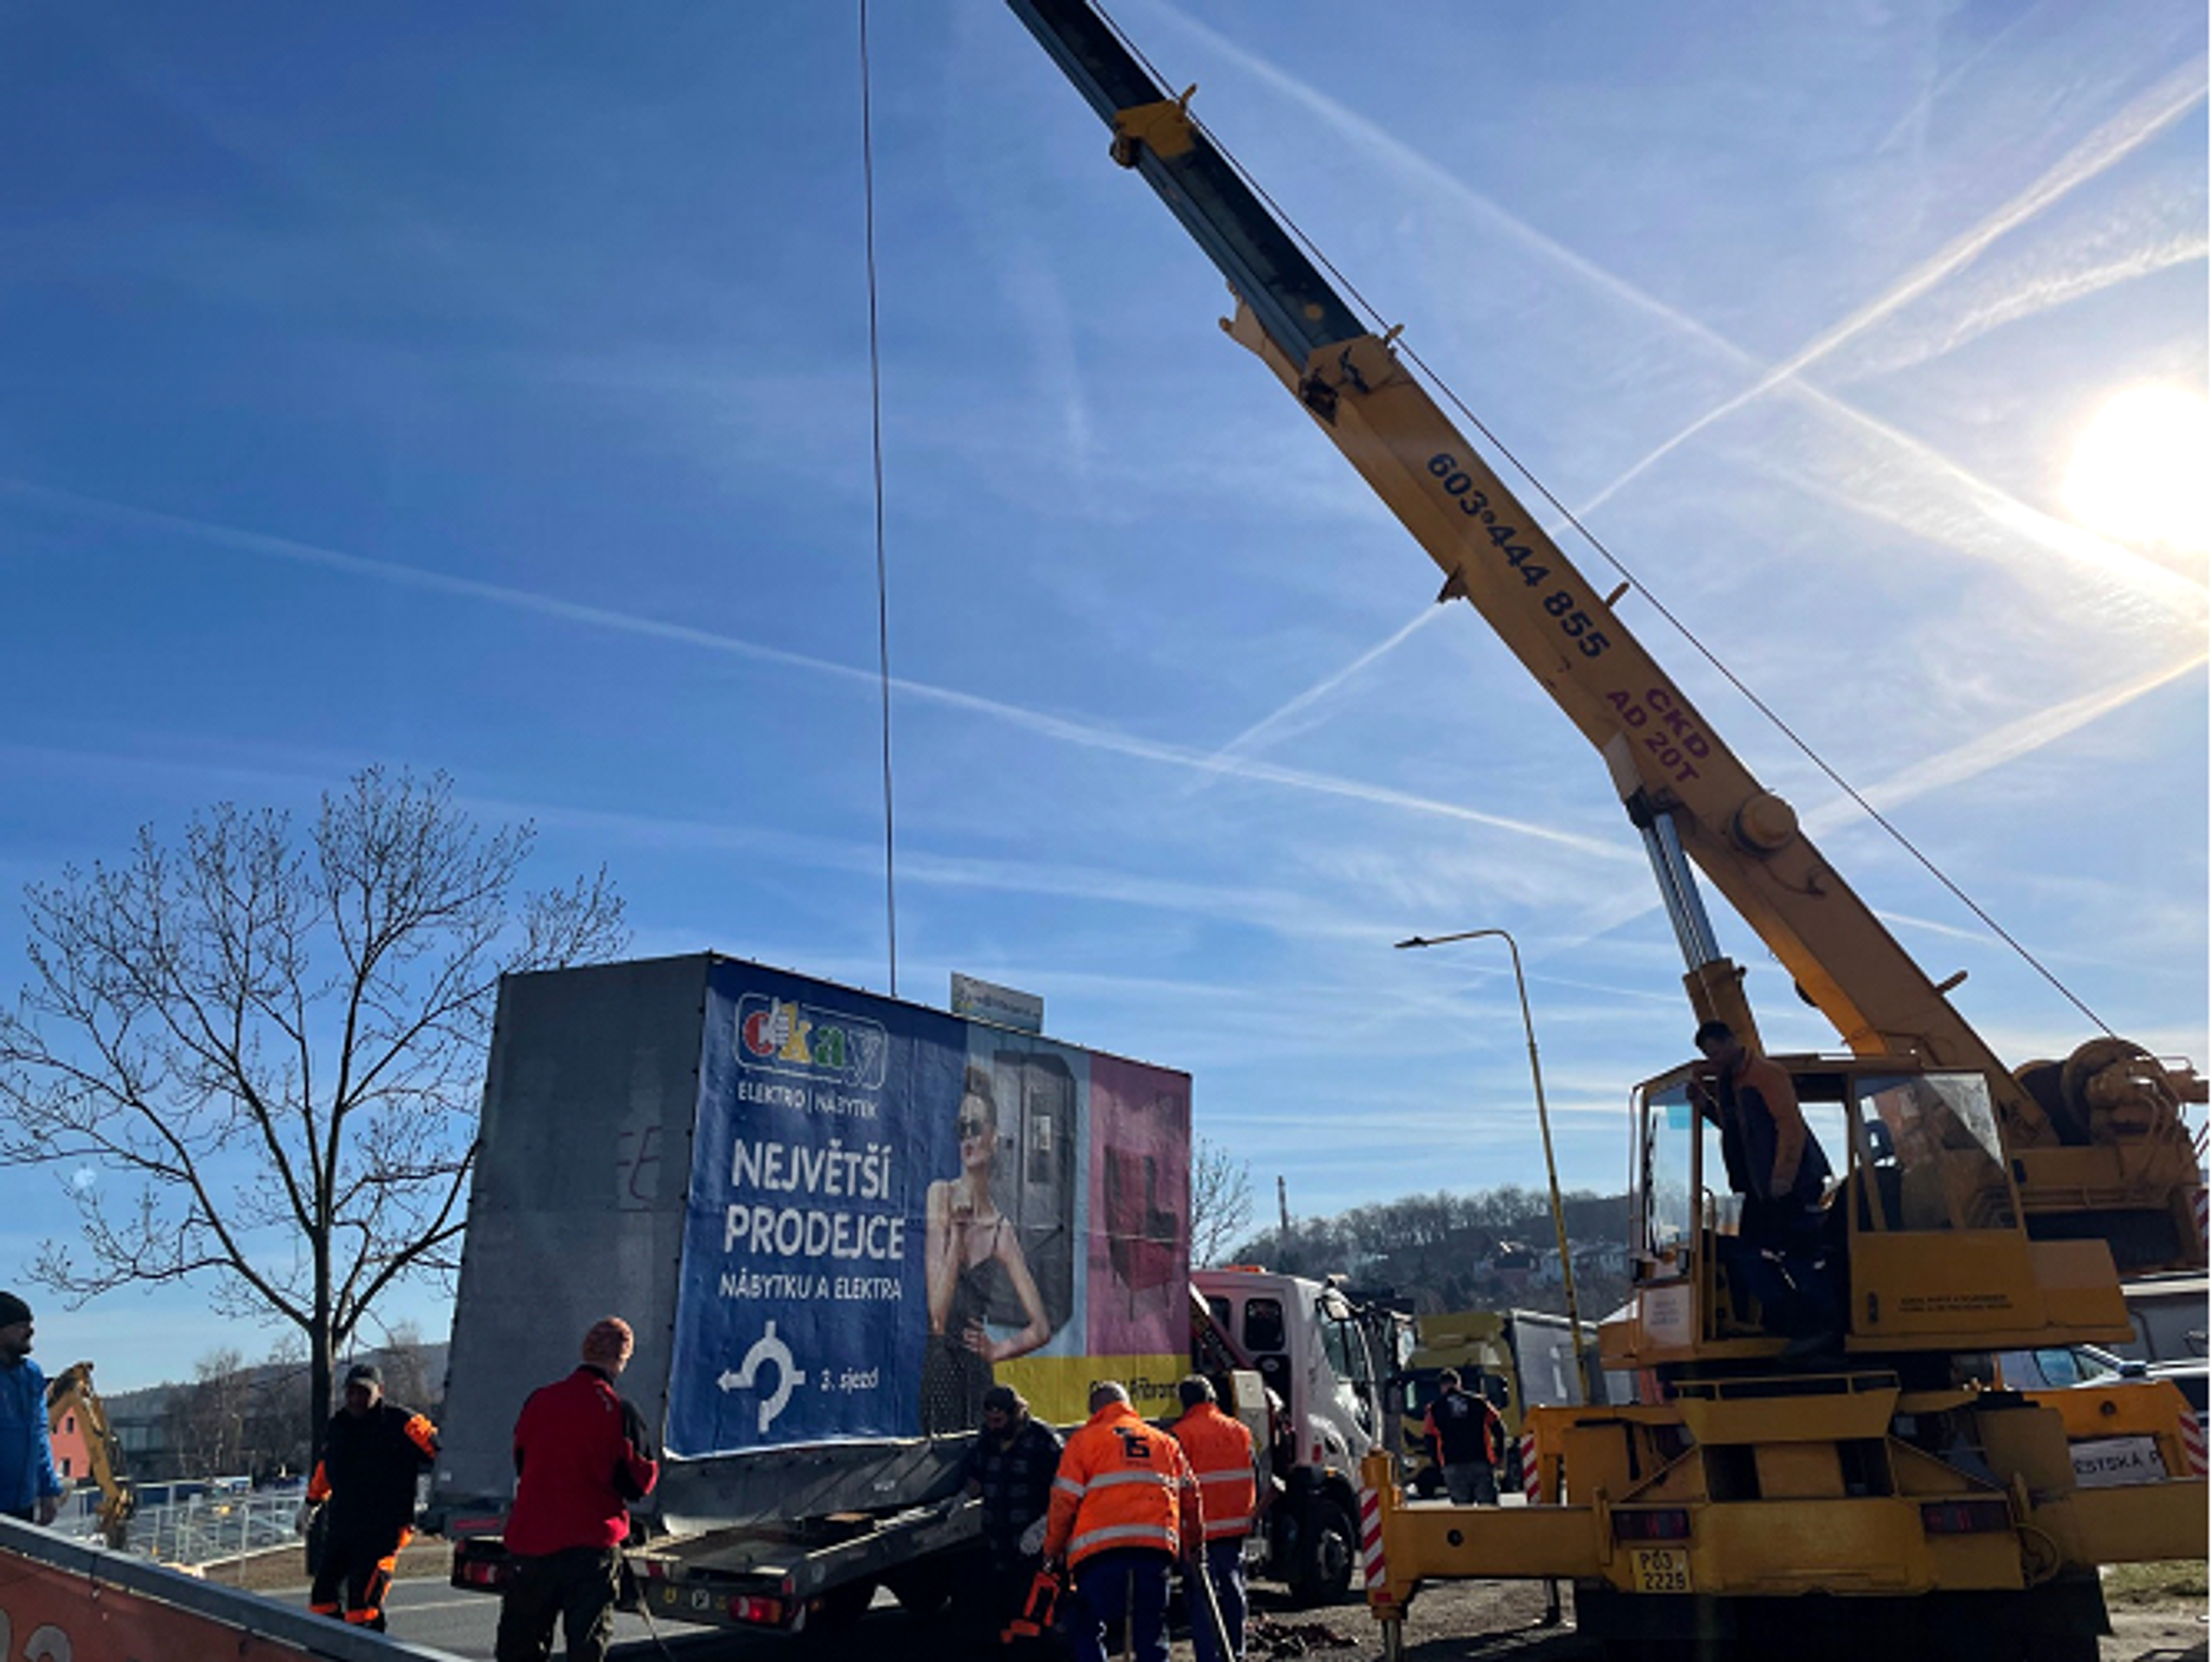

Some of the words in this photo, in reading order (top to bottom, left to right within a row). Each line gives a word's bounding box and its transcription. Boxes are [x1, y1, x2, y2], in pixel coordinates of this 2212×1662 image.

[1427, 453, 1488, 517] 603
[1486, 525, 1551, 588] 444
[1543, 589, 1611, 657] 855
[1606, 690, 1648, 728] AD
[1643, 731, 1699, 783] 20T
[1646, 688, 1711, 759] CKD
[738, 1081, 805, 1108] ELEKTRO
[732, 1138, 892, 1200] NEJVĚTŠÍ
[725, 1204, 906, 1259] PRODEJCE
[719, 1266, 813, 1299] NÁBYTKU
[815, 1277, 829, 1299] A
[834, 1276, 903, 1301] ELEKTRA
